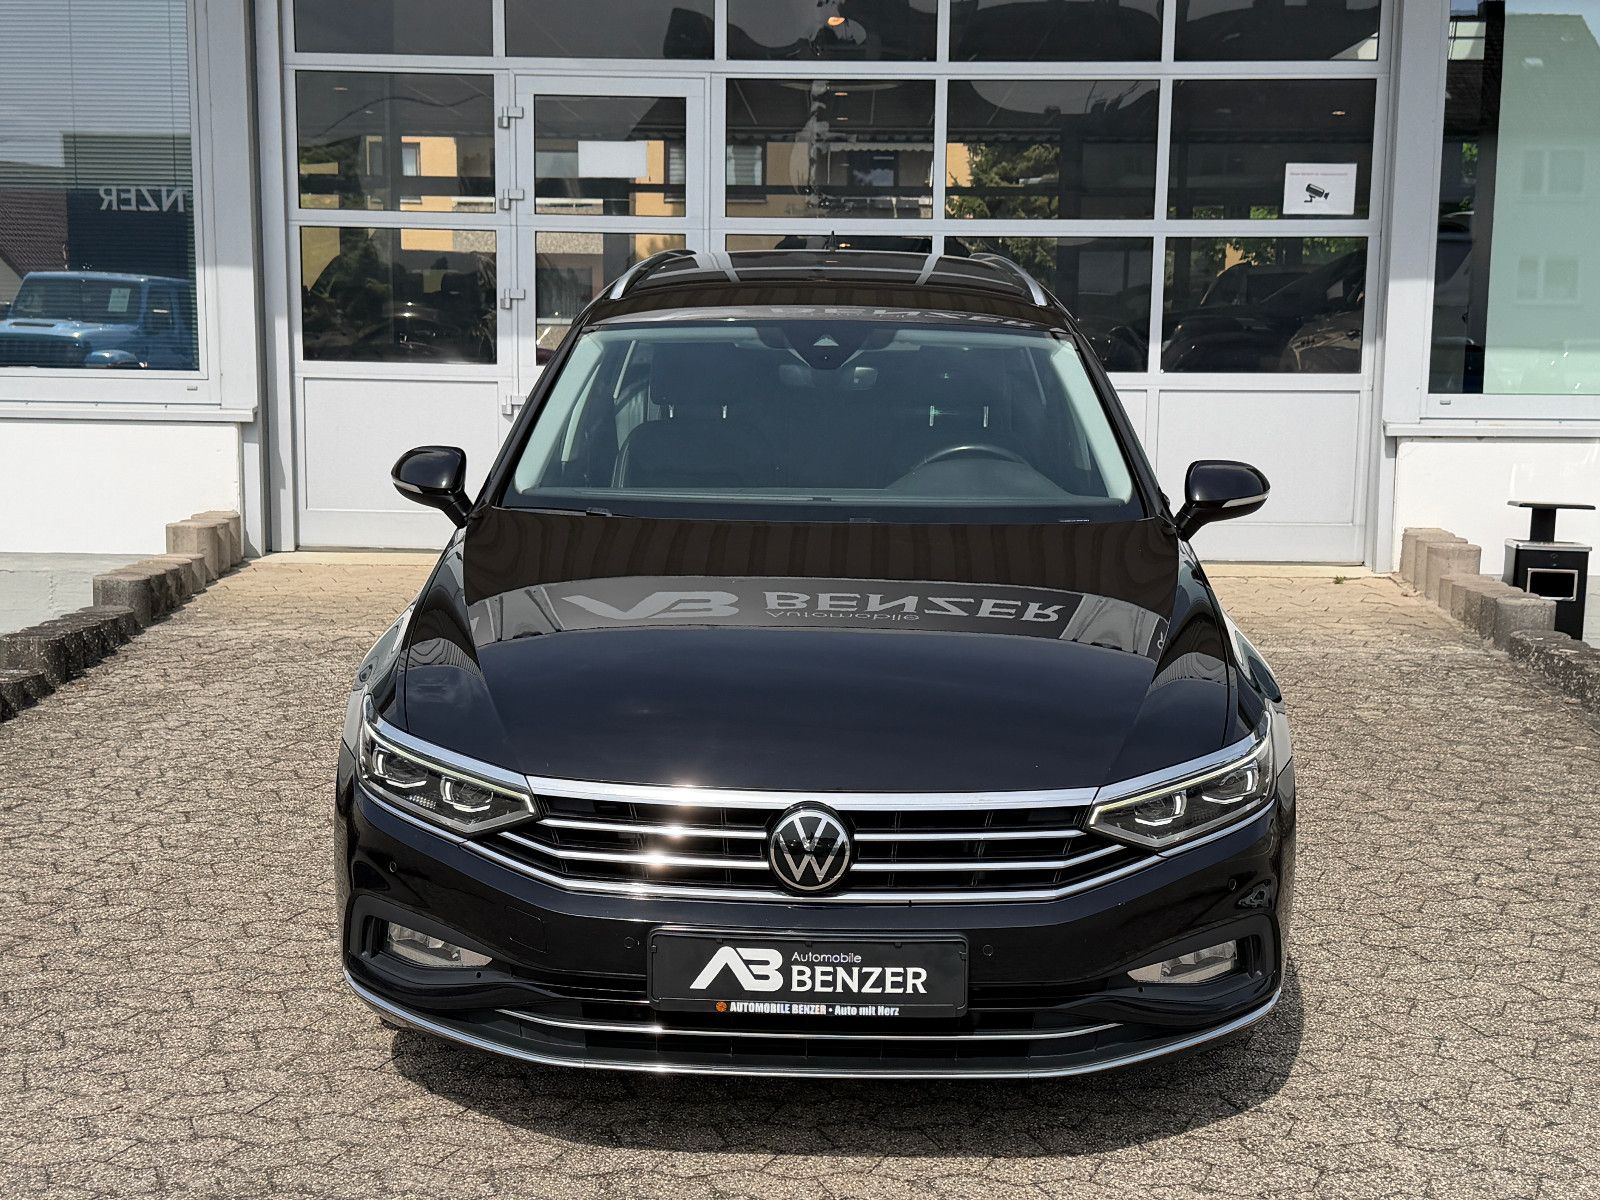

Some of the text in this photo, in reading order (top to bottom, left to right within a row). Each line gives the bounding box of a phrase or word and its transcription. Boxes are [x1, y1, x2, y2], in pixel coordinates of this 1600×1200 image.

[791, 951, 862, 964] Automobile
[791, 965, 928, 994] BENZER
[729, 1002, 900, 1016] AUTOMOBILE BENZER Auto mit Herz
